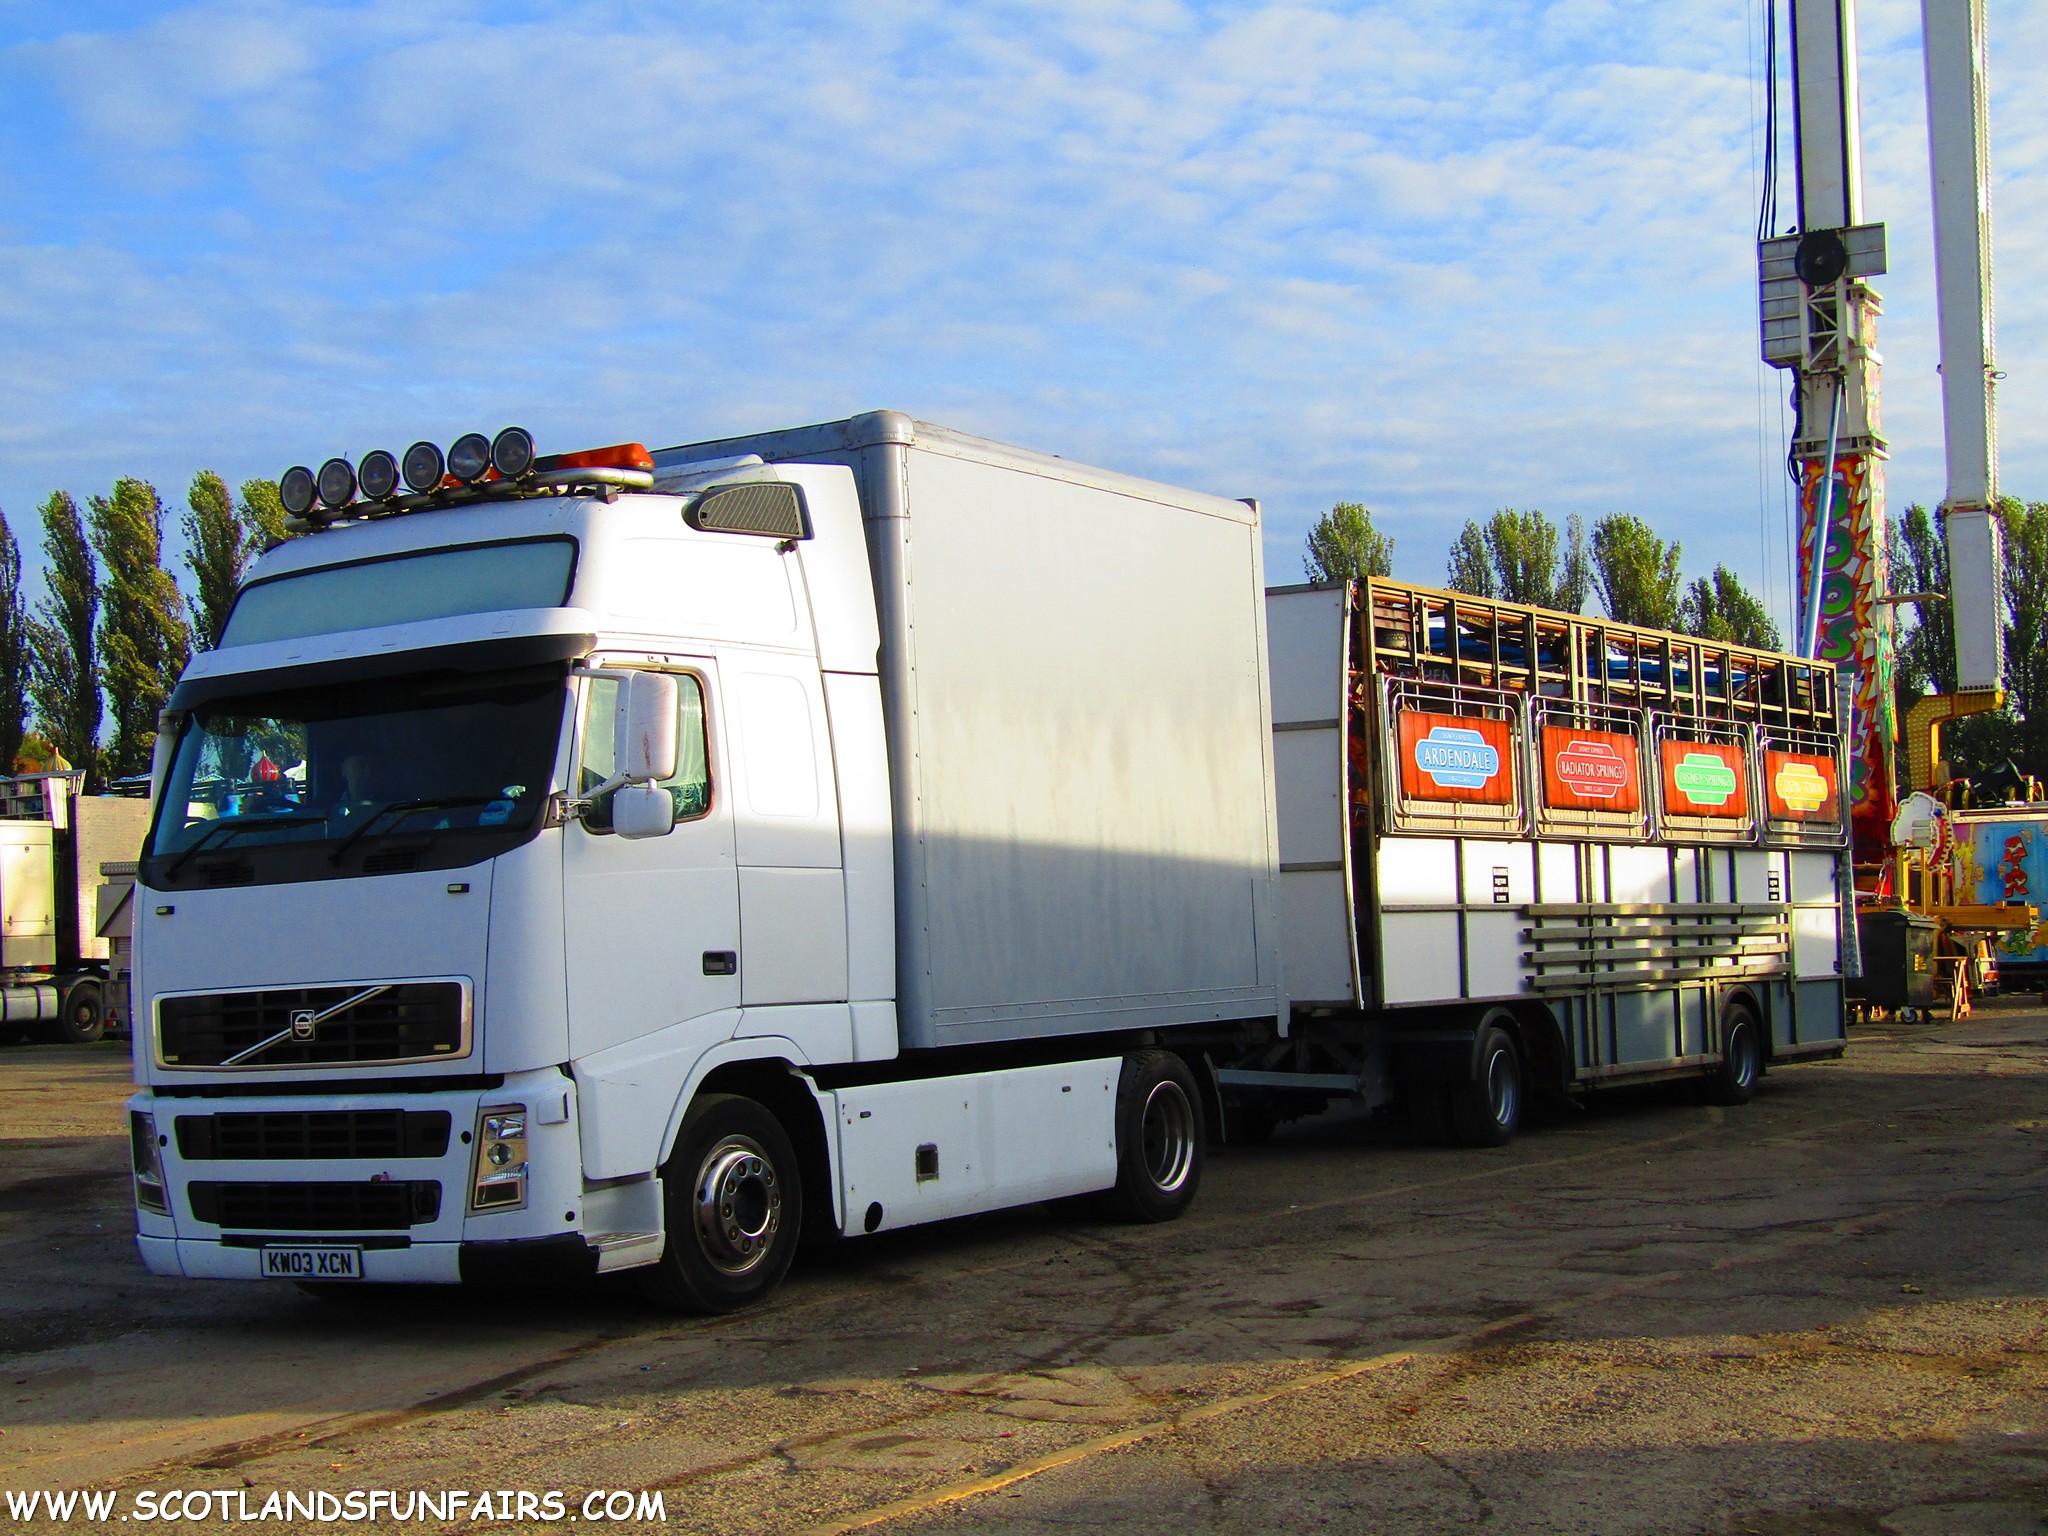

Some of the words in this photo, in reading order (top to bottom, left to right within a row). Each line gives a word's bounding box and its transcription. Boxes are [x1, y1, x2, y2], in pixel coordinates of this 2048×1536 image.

[1424, 747, 1491, 771] ARDENDALE
[1561, 760, 1595, 777] RADIATOR
[1596, 764, 1623, 779] SPRINGS
[1679, 771, 1703, 786] DISNEY
[1704, 773, 1733, 787] SPRINGS
[268, 1252, 313, 1272] KW03
[317, 1252, 352, 1274] XCN
